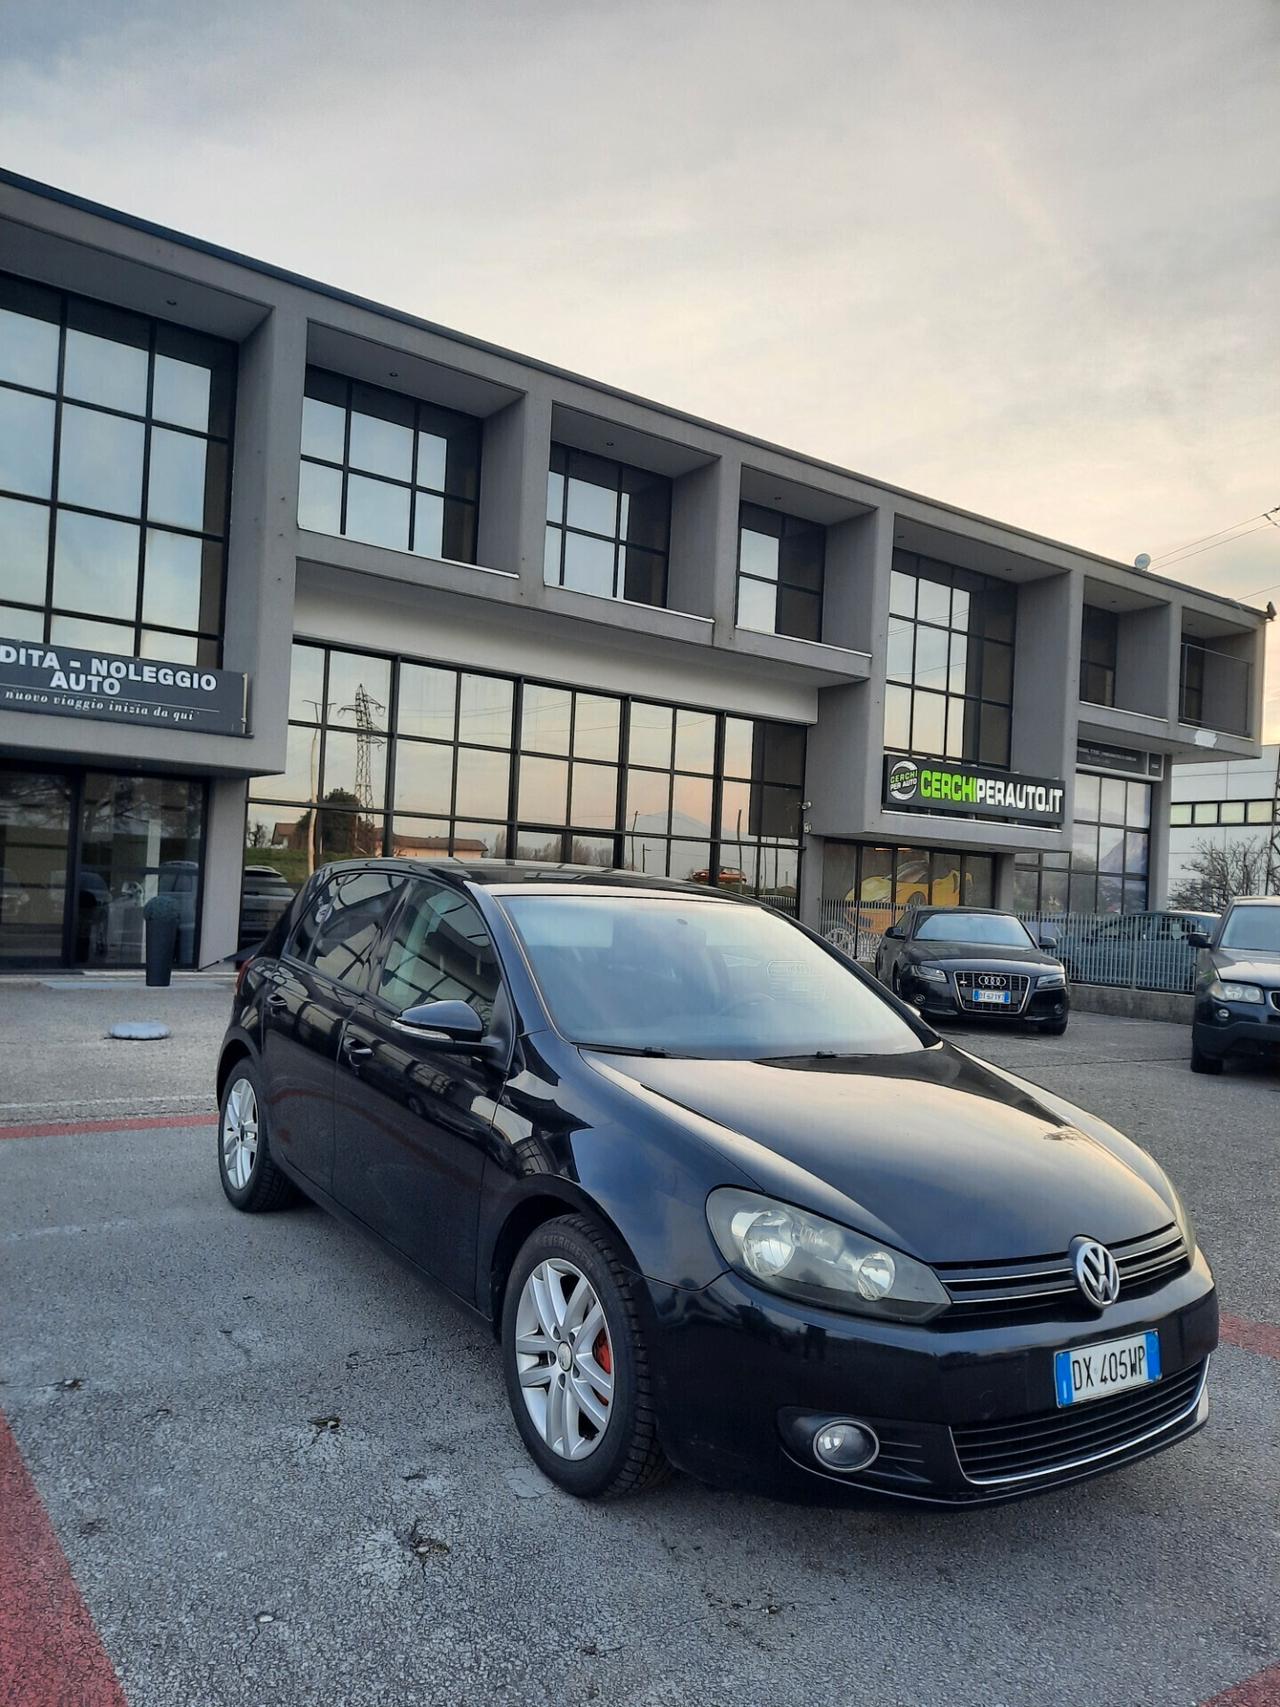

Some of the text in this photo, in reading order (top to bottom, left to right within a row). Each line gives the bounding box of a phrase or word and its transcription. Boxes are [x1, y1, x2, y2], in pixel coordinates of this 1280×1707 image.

[0, 644, 60, 670] DITA
[91, 657, 217, 691] NOLEGGIO
[50, 670, 121, 695] AUTO
[5, 690, 194, 722] nuovo viaggio inizia da qui
[890, 770, 918, 784] CERCHI
[1072, 1345, 1146, 1391] DX 405WP
